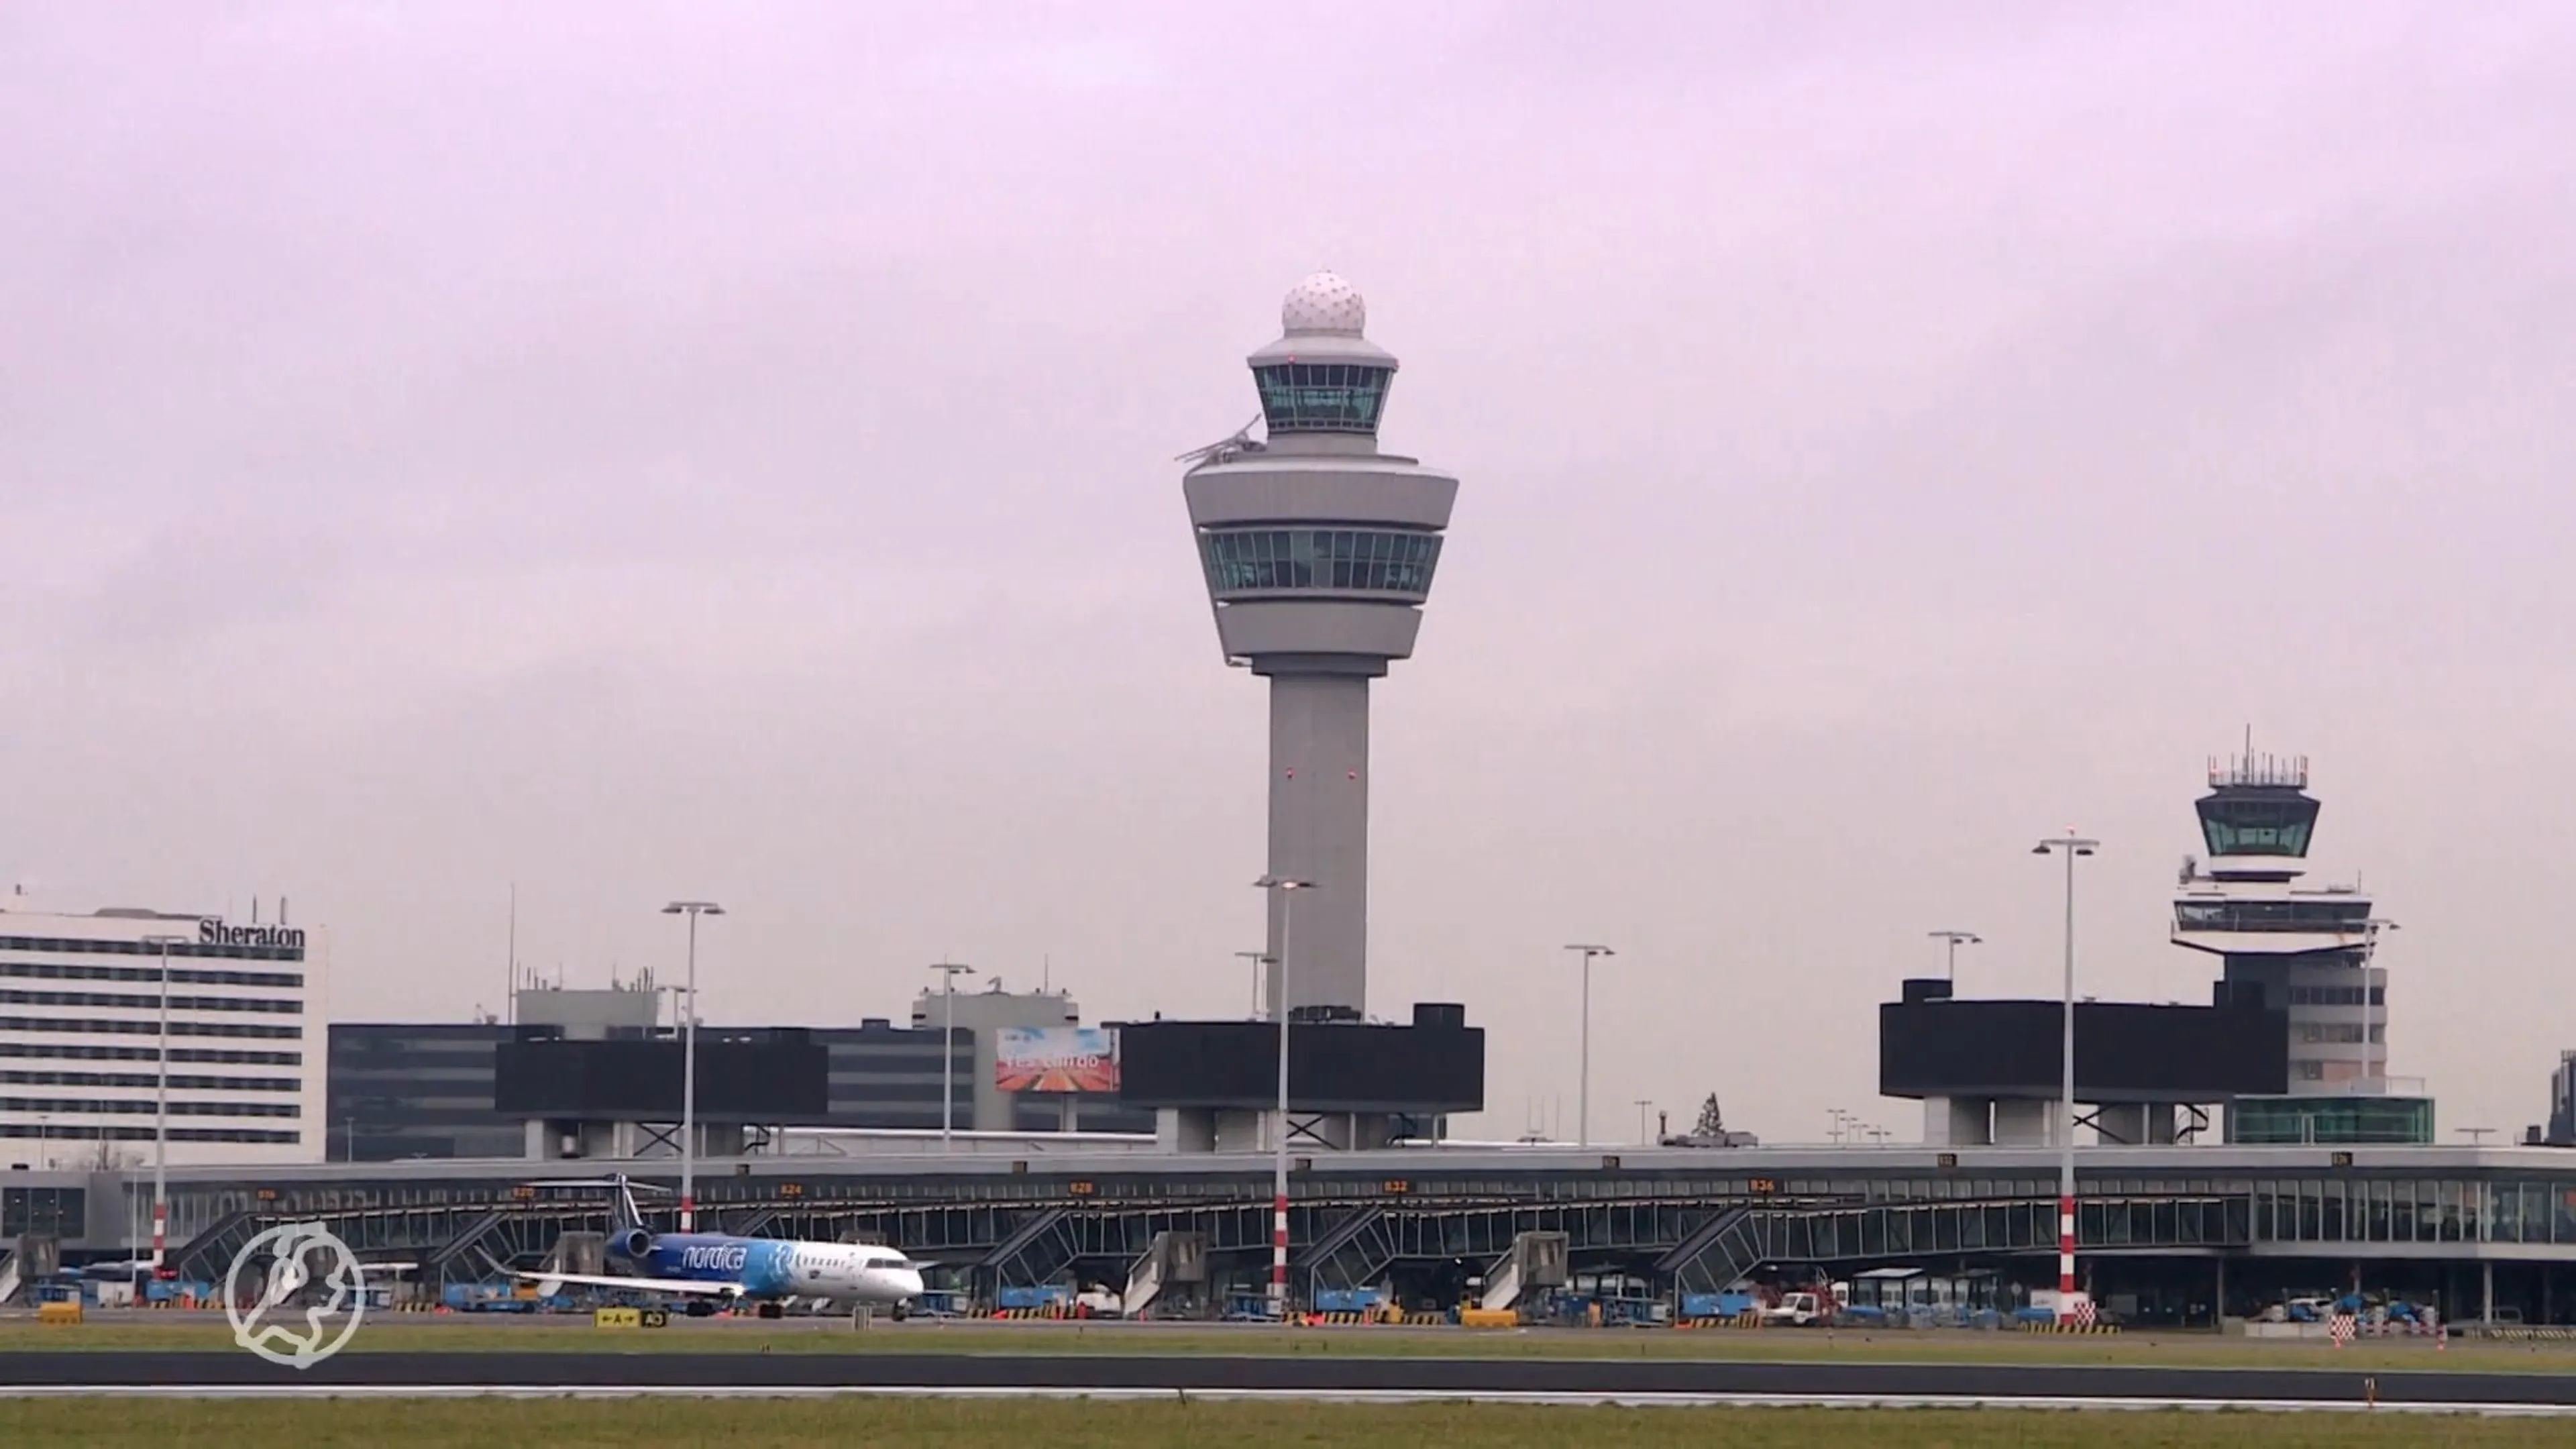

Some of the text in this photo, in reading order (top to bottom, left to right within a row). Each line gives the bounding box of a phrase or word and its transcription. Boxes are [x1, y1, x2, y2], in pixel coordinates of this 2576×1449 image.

[199, 919, 305, 947] Sheraton
[682, 1244, 747, 1271] nordica
[613, 1313, 622, 1326] A
